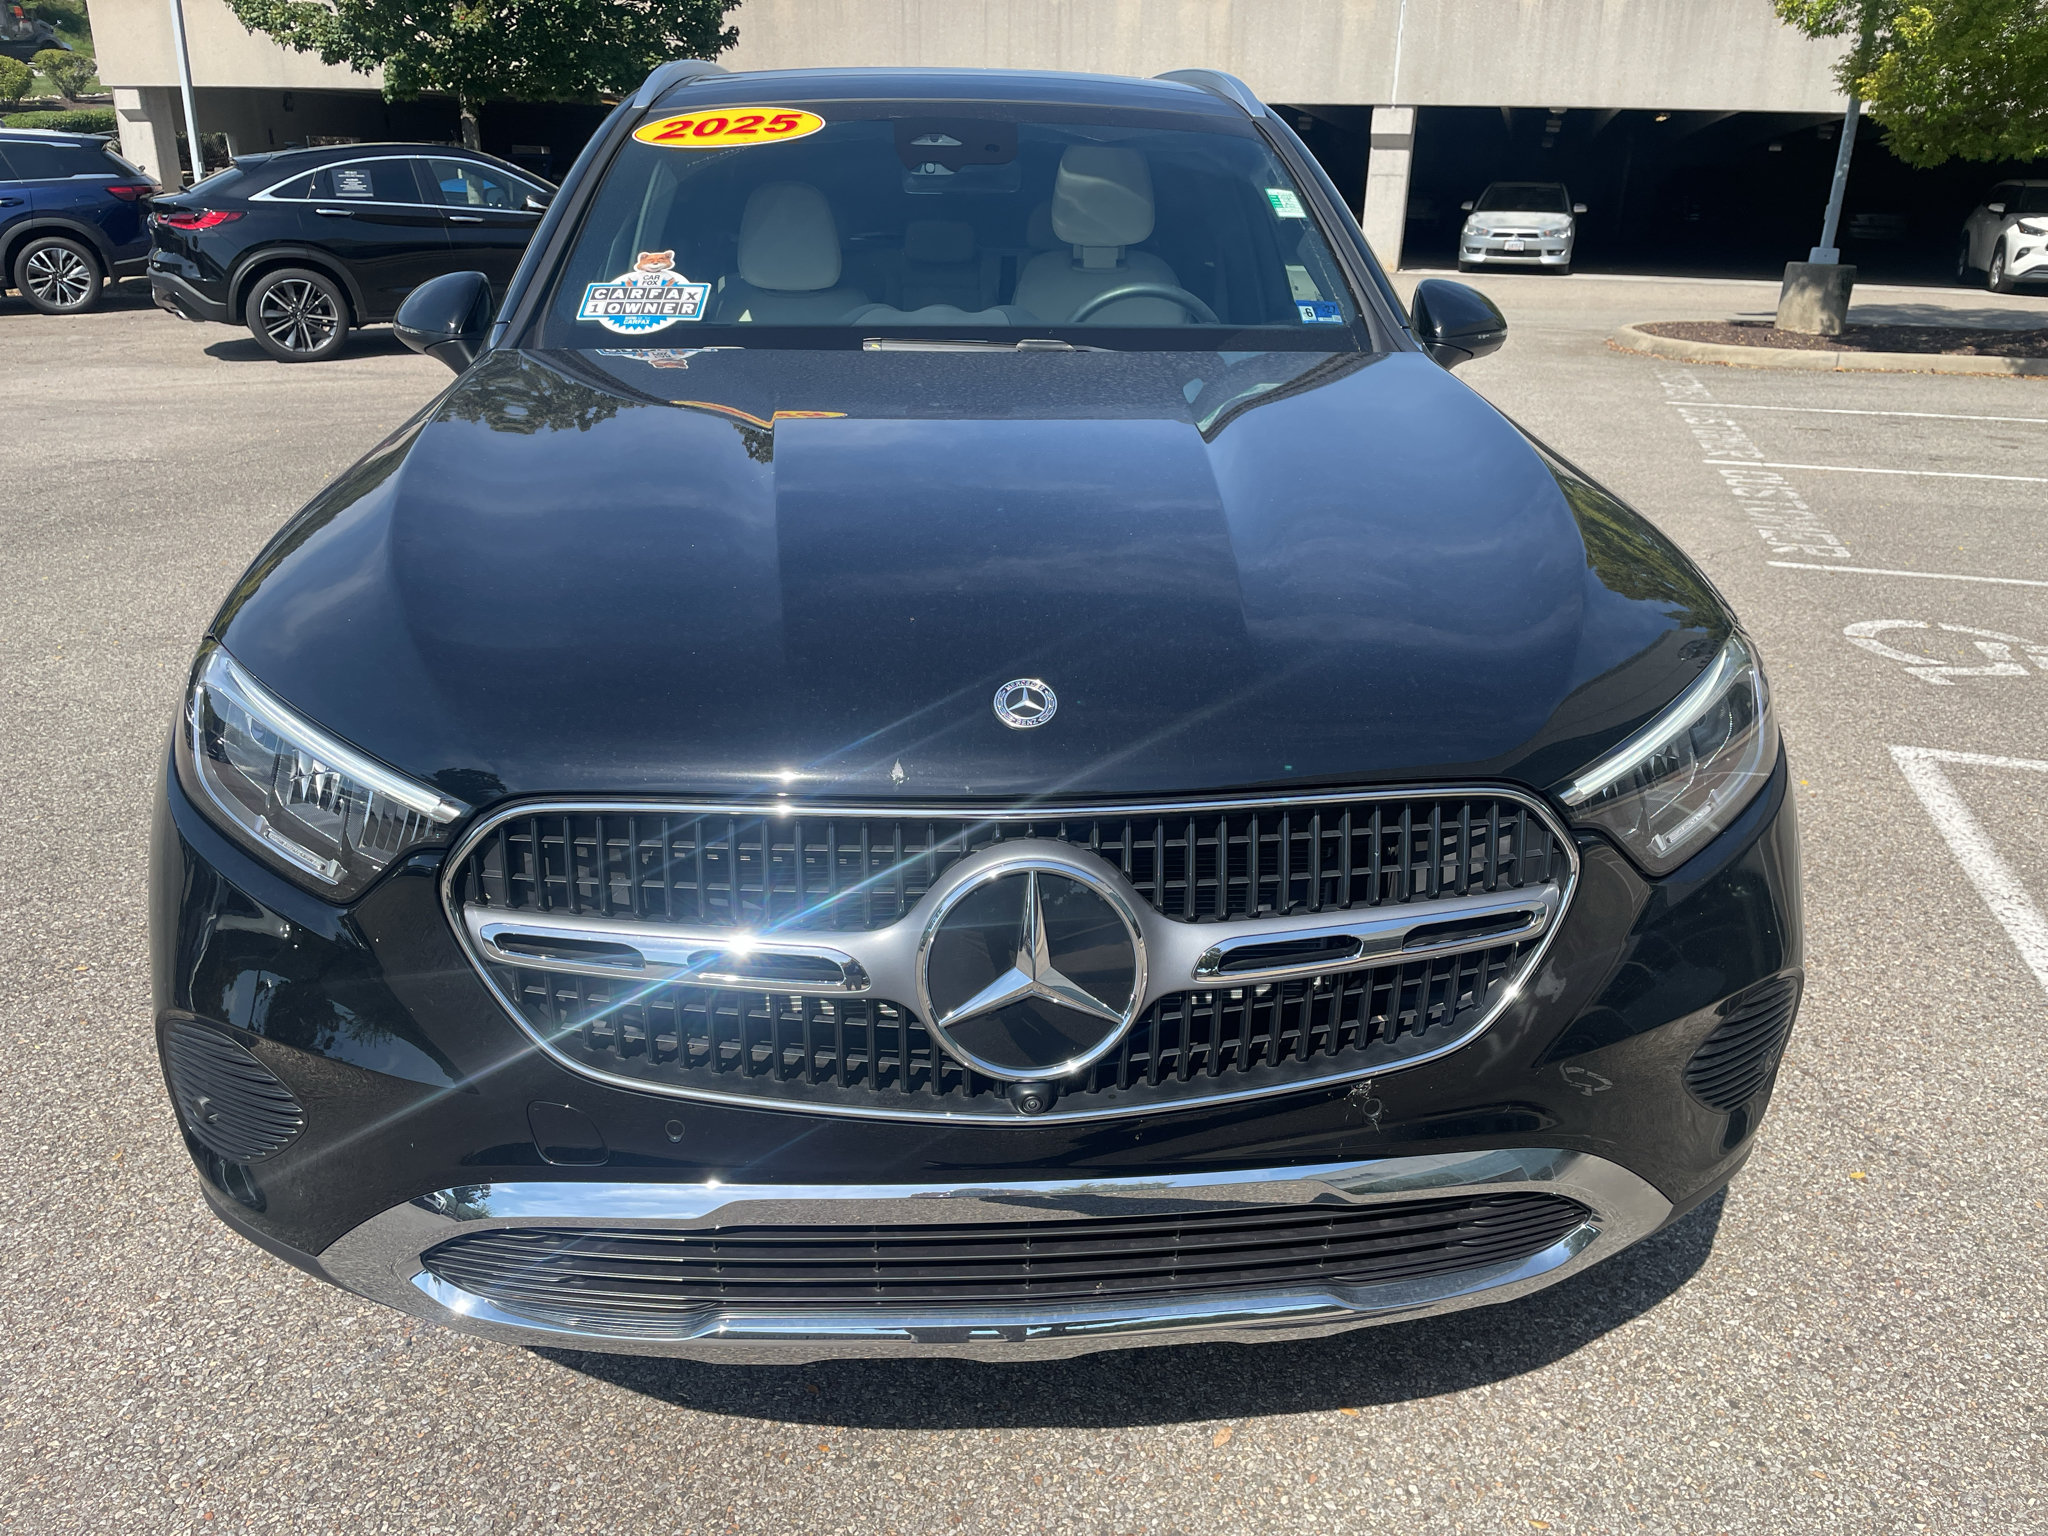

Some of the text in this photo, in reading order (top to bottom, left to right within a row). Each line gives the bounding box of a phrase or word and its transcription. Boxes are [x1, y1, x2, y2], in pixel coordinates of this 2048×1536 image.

[652, 114, 803, 141] 2025
[593, 288, 698, 301] CARFAX
[589, 302, 694, 314] 1 OWNER
[1305, 307, 1313, 318] 6
